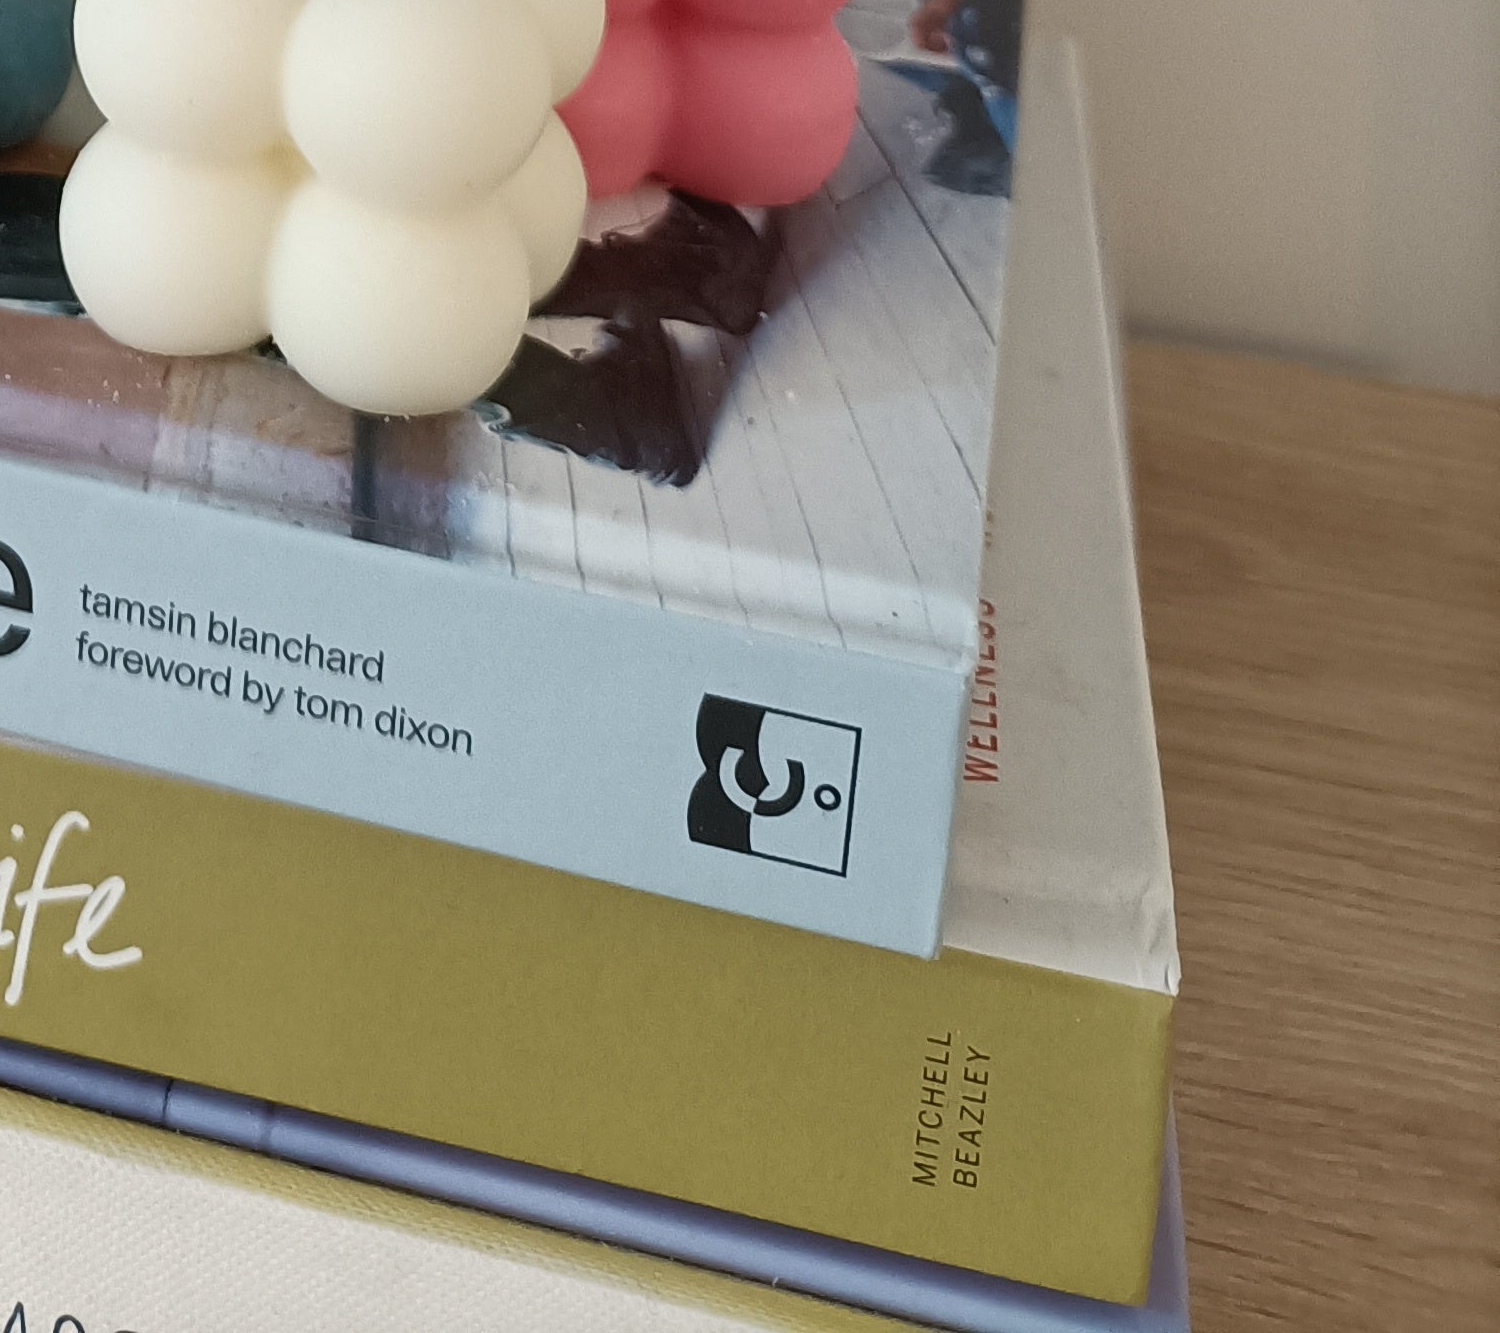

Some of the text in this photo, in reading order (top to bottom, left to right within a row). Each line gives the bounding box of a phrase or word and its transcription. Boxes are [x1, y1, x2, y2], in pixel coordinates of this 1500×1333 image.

[75, 630, 474, 757] foreword by tom dixon
[79, 583, 385, 684] tamsin blanchard
[911, 1031, 952, 1187] MITCHELL
[952, 1044, 991, 1188] BEAZLEY
